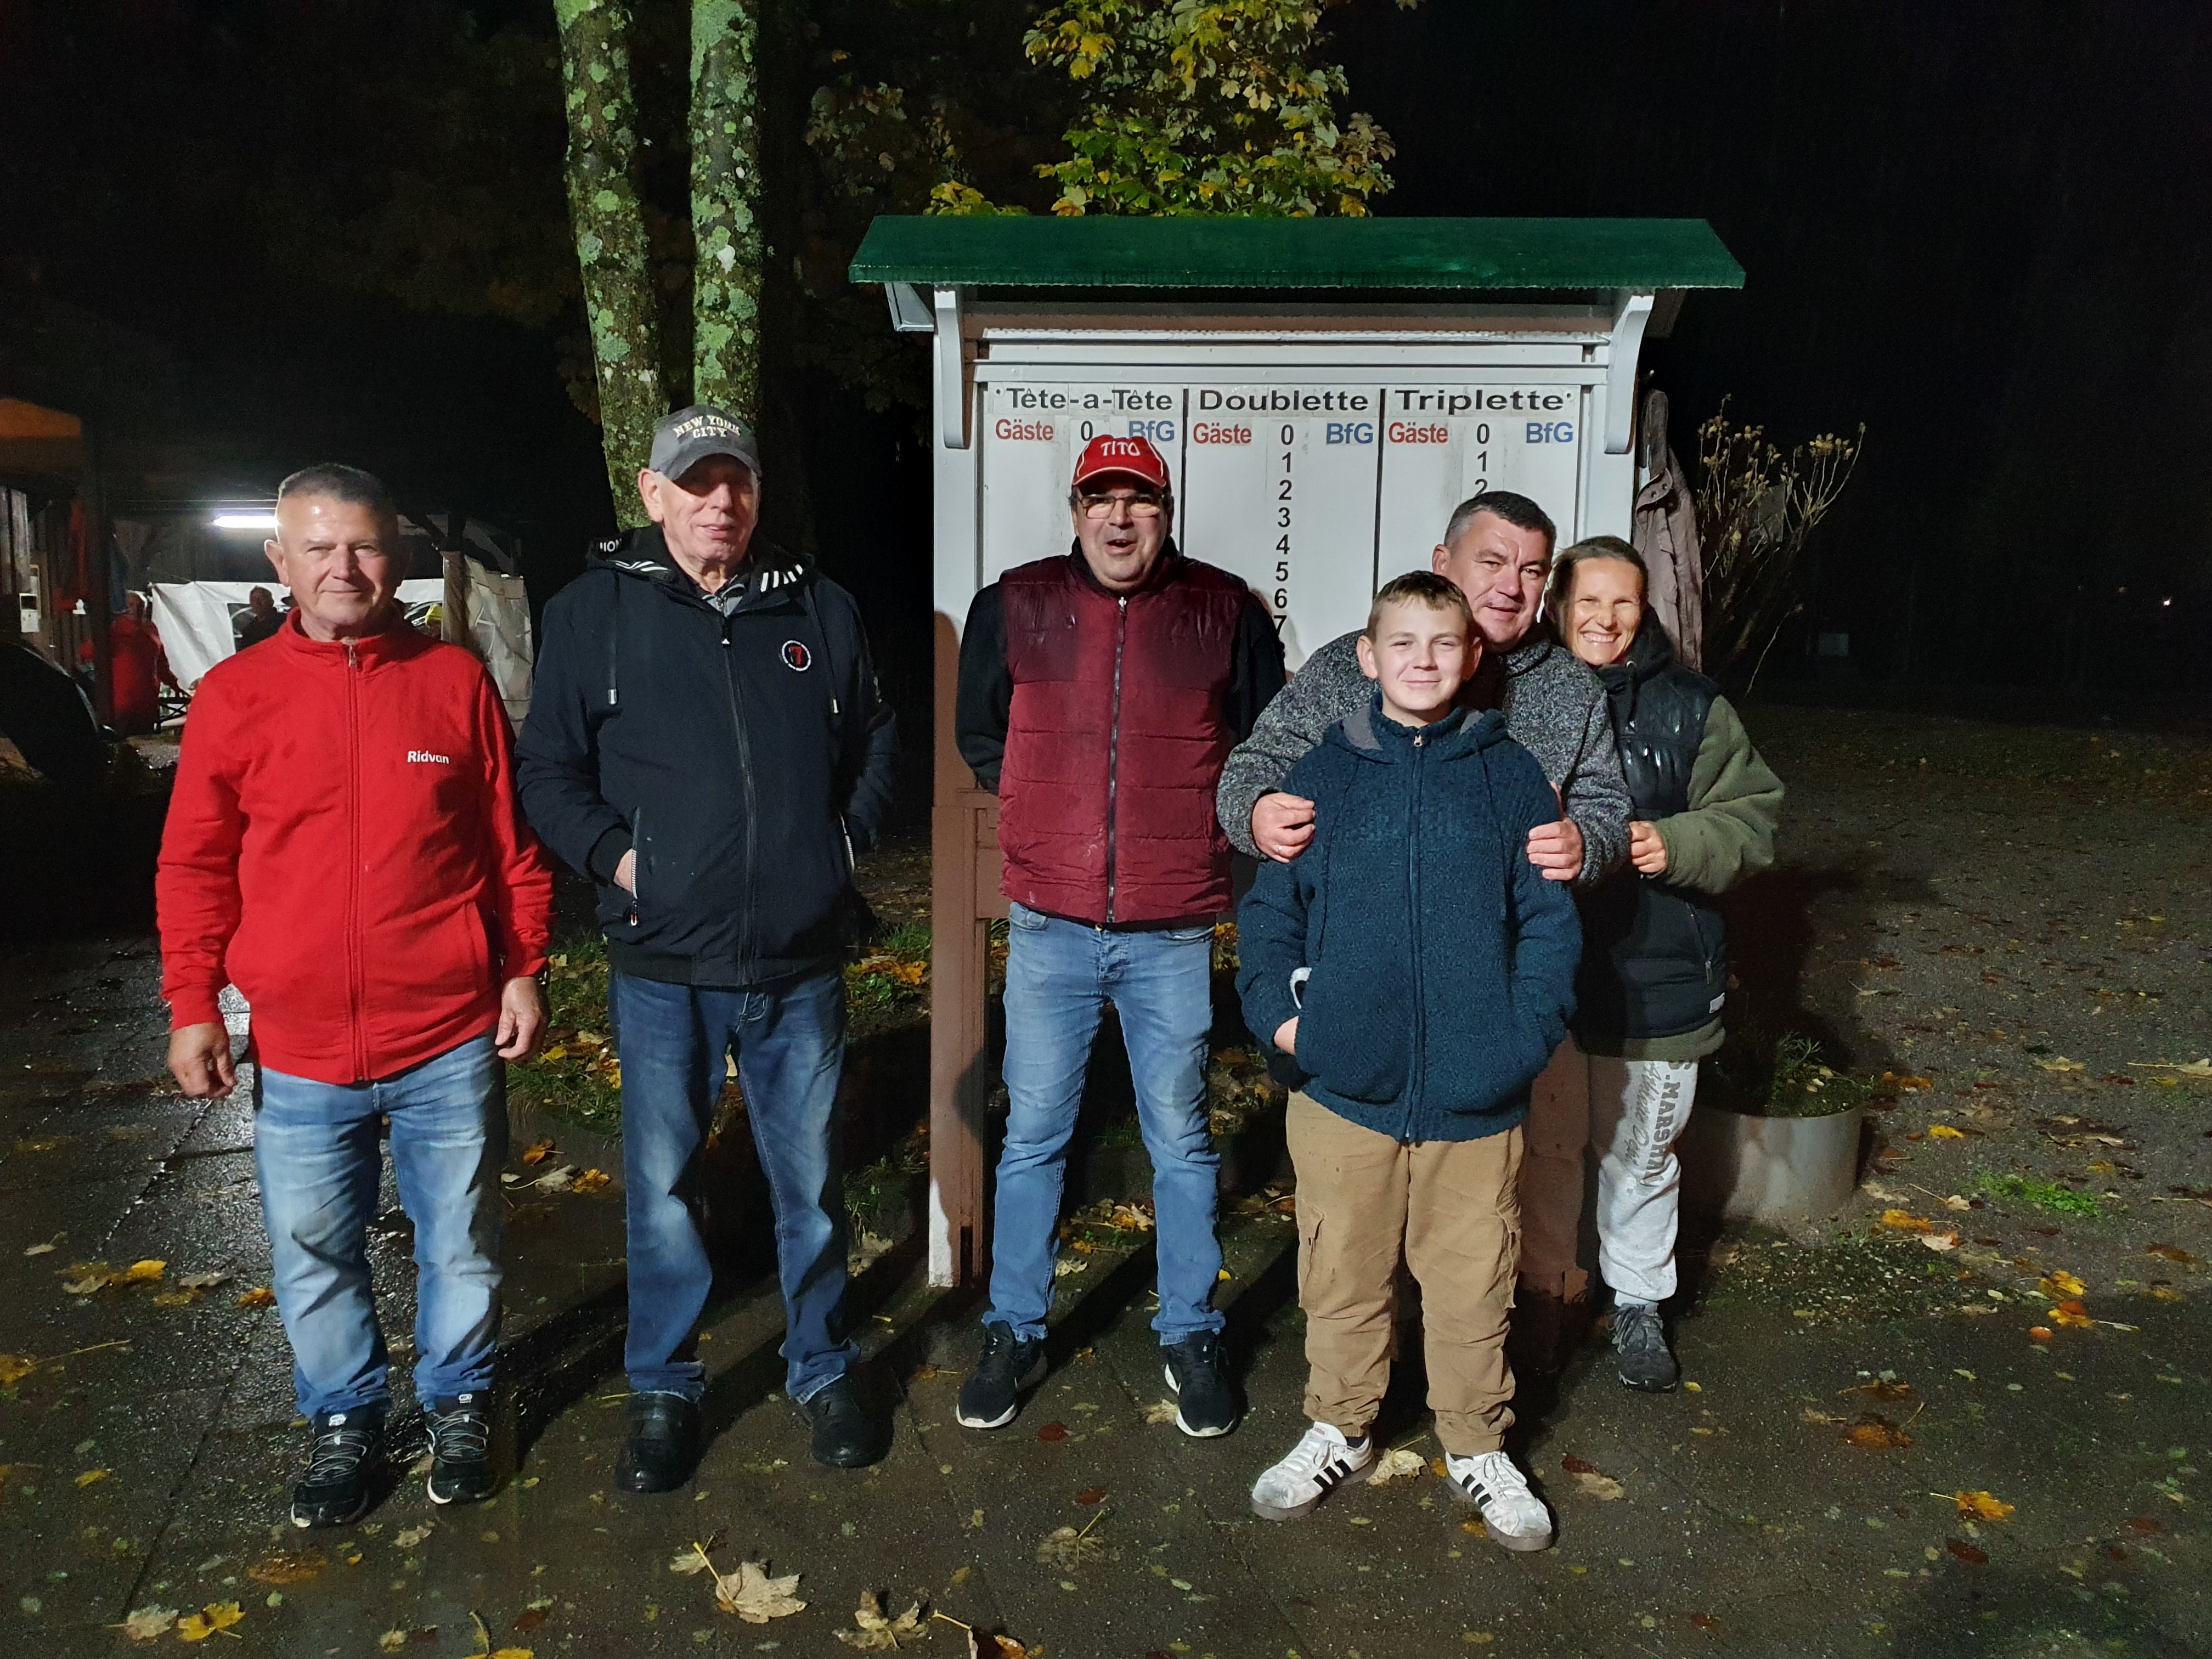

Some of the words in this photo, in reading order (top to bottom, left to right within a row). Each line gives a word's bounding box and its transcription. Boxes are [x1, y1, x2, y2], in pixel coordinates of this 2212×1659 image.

[1006, 388, 1172, 410] Tête-a-Tête
[1200, 390, 1368, 410] Doublette
[1395, 390, 1564, 415] Triplette
[673, 416, 703, 438] NEW
[707, 415, 741, 436] YORK
[693, 426, 727, 438] CITY
[996, 419, 1054, 441] Gäste
[1081, 421, 1093, 441] 0
[1128, 420, 1175, 442] BfG
[1193, 422, 1252, 444] Gäste
[1281, 424, 1294, 445] 0
[1326, 423, 1374, 444] BfG
[1389, 421, 1448, 444] Gäste
[1476, 424, 1490, 444] 0
[1526, 422, 1573, 443] BfG
[1101, 441, 1141, 456] TITO
[1282, 452, 1291, 473] 1
[1477, 450, 1487, 472] 1
[1278, 479, 1293, 500] 2
[1475, 478, 1488, 497] 2
[1277, 507, 1291, 528] 3
[1276, 534, 1290, 555] 4
[1276, 561, 1289, 582] 5
[1274, 588, 1288, 609] 6
[1274, 615, 1287, 636] 7
[408, 750, 449, 765] Ridvan
